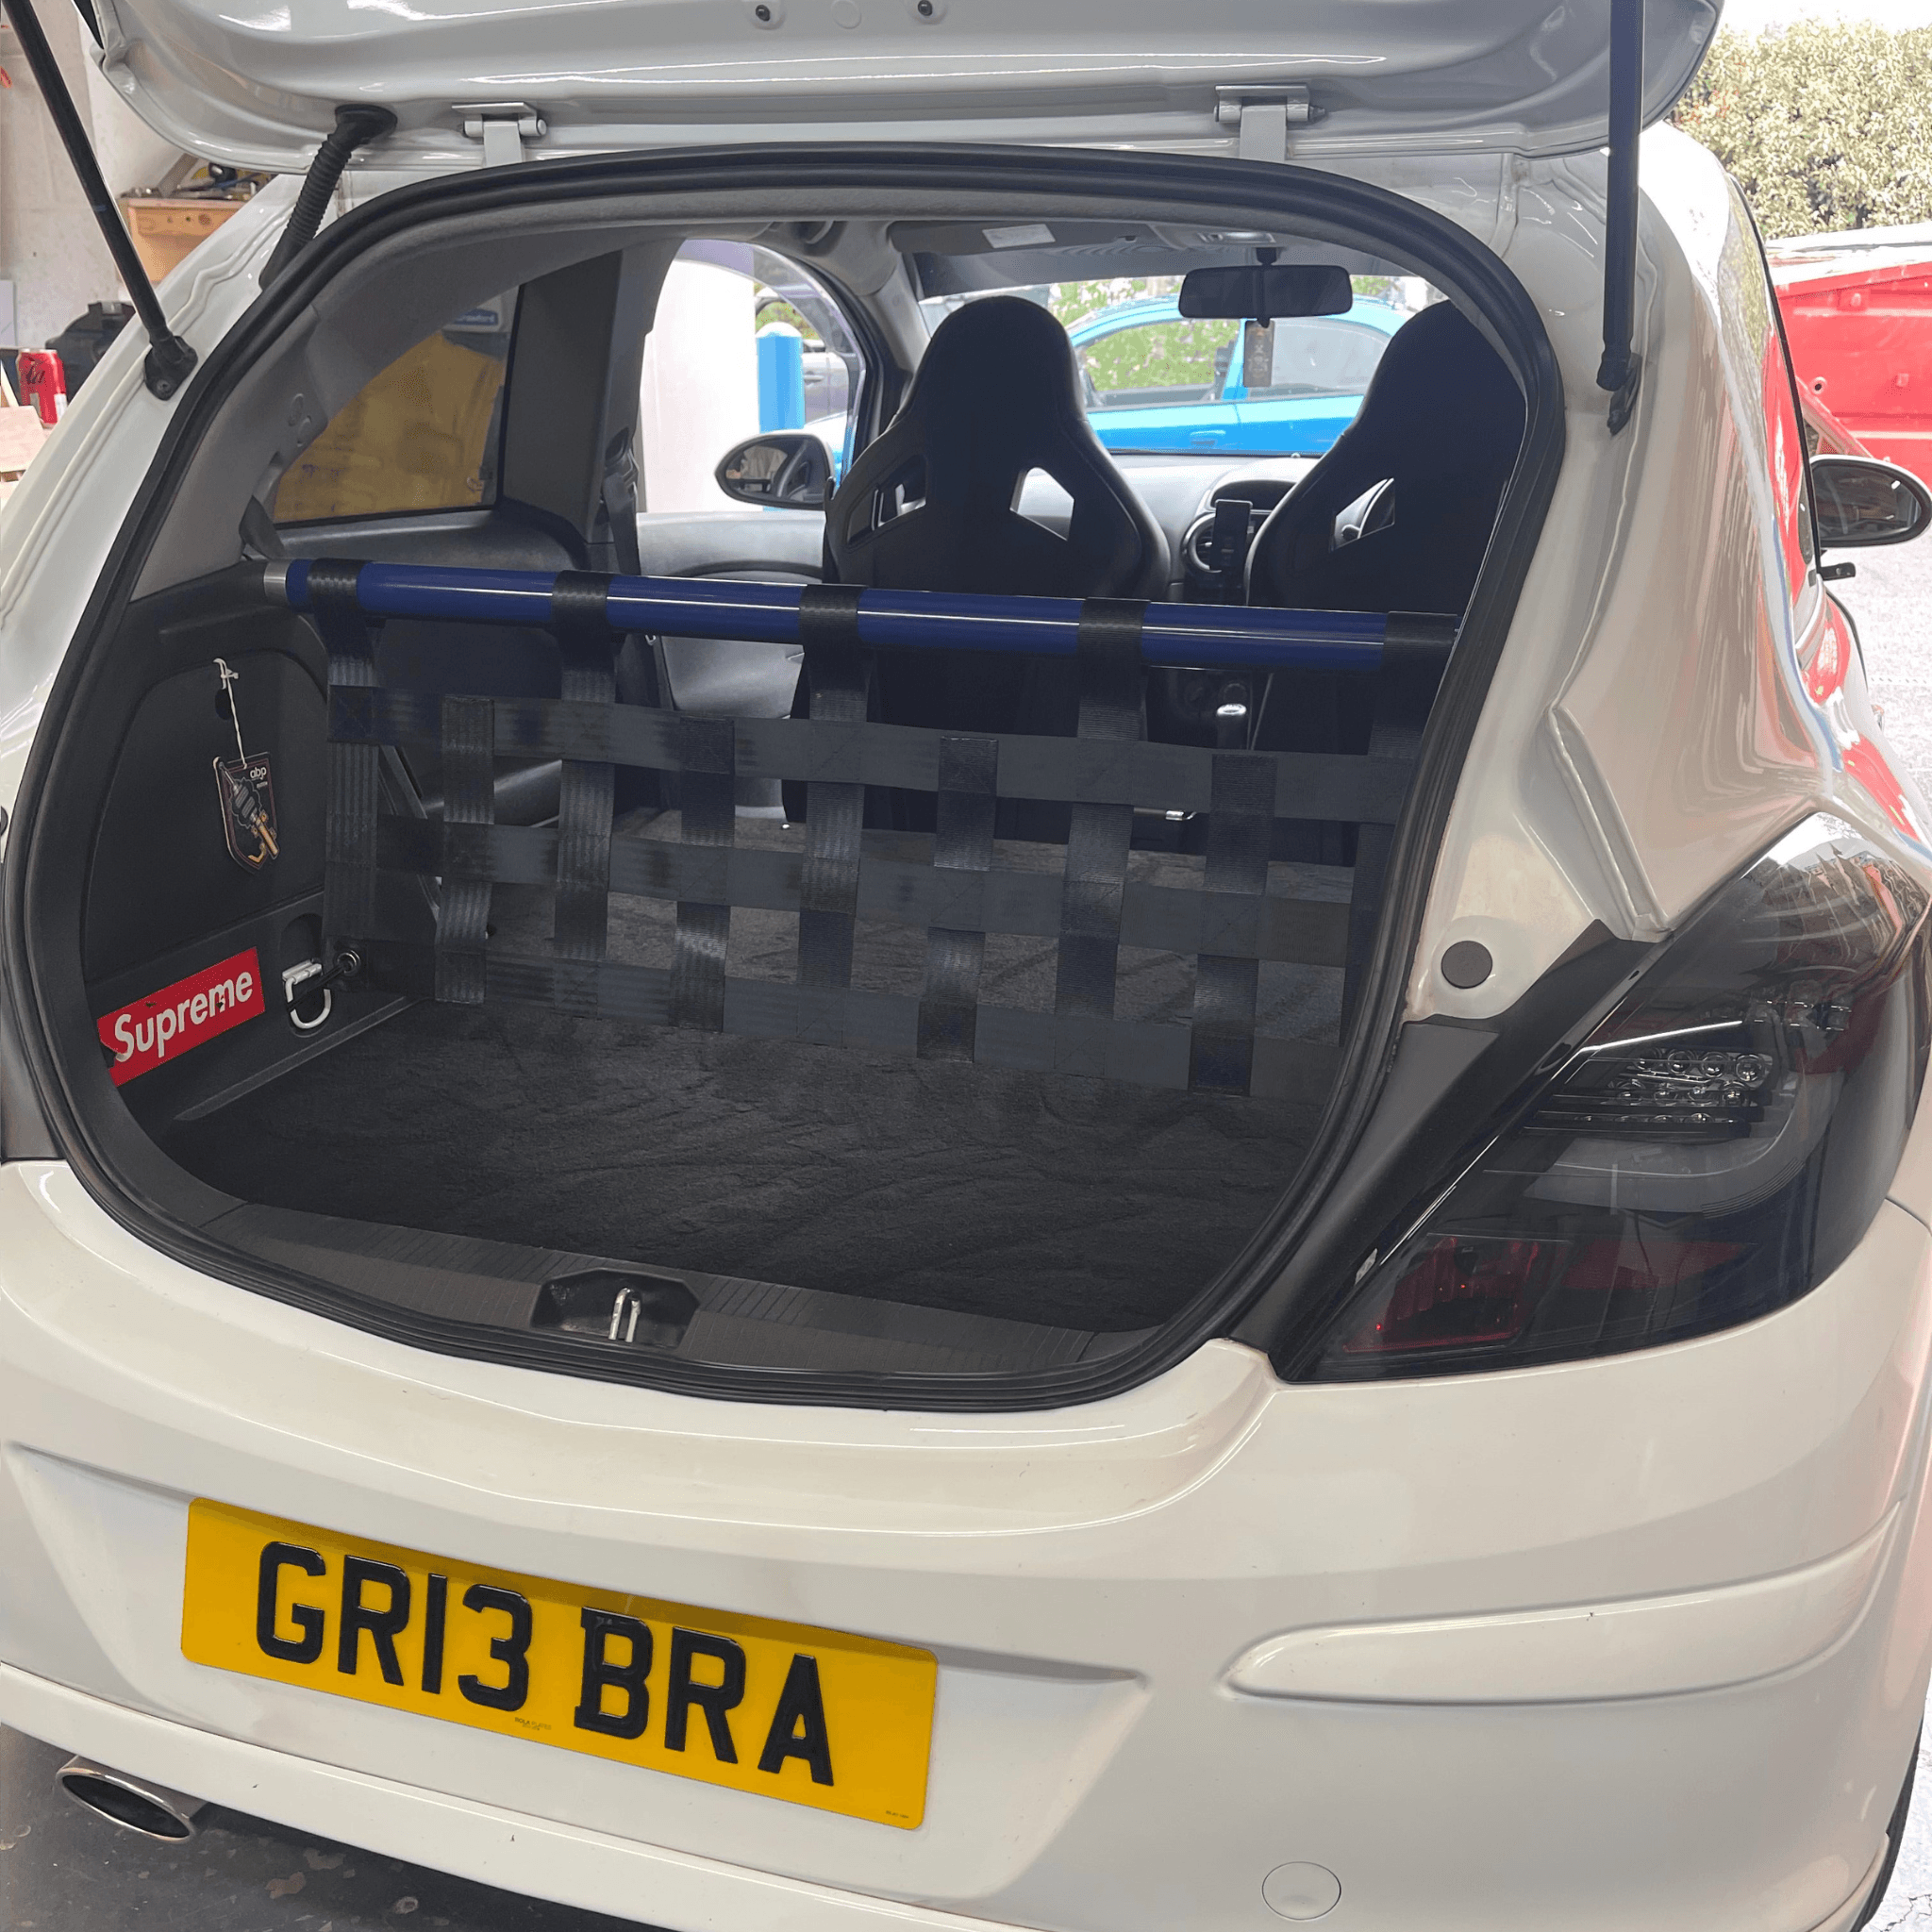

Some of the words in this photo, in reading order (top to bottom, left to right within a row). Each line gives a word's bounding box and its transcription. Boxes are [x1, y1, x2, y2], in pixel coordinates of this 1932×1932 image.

[114, 972, 253, 1062] Supreme
[257, 1541, 533, 1712] GR13
[574, 1607, 835, 1786] BRA
